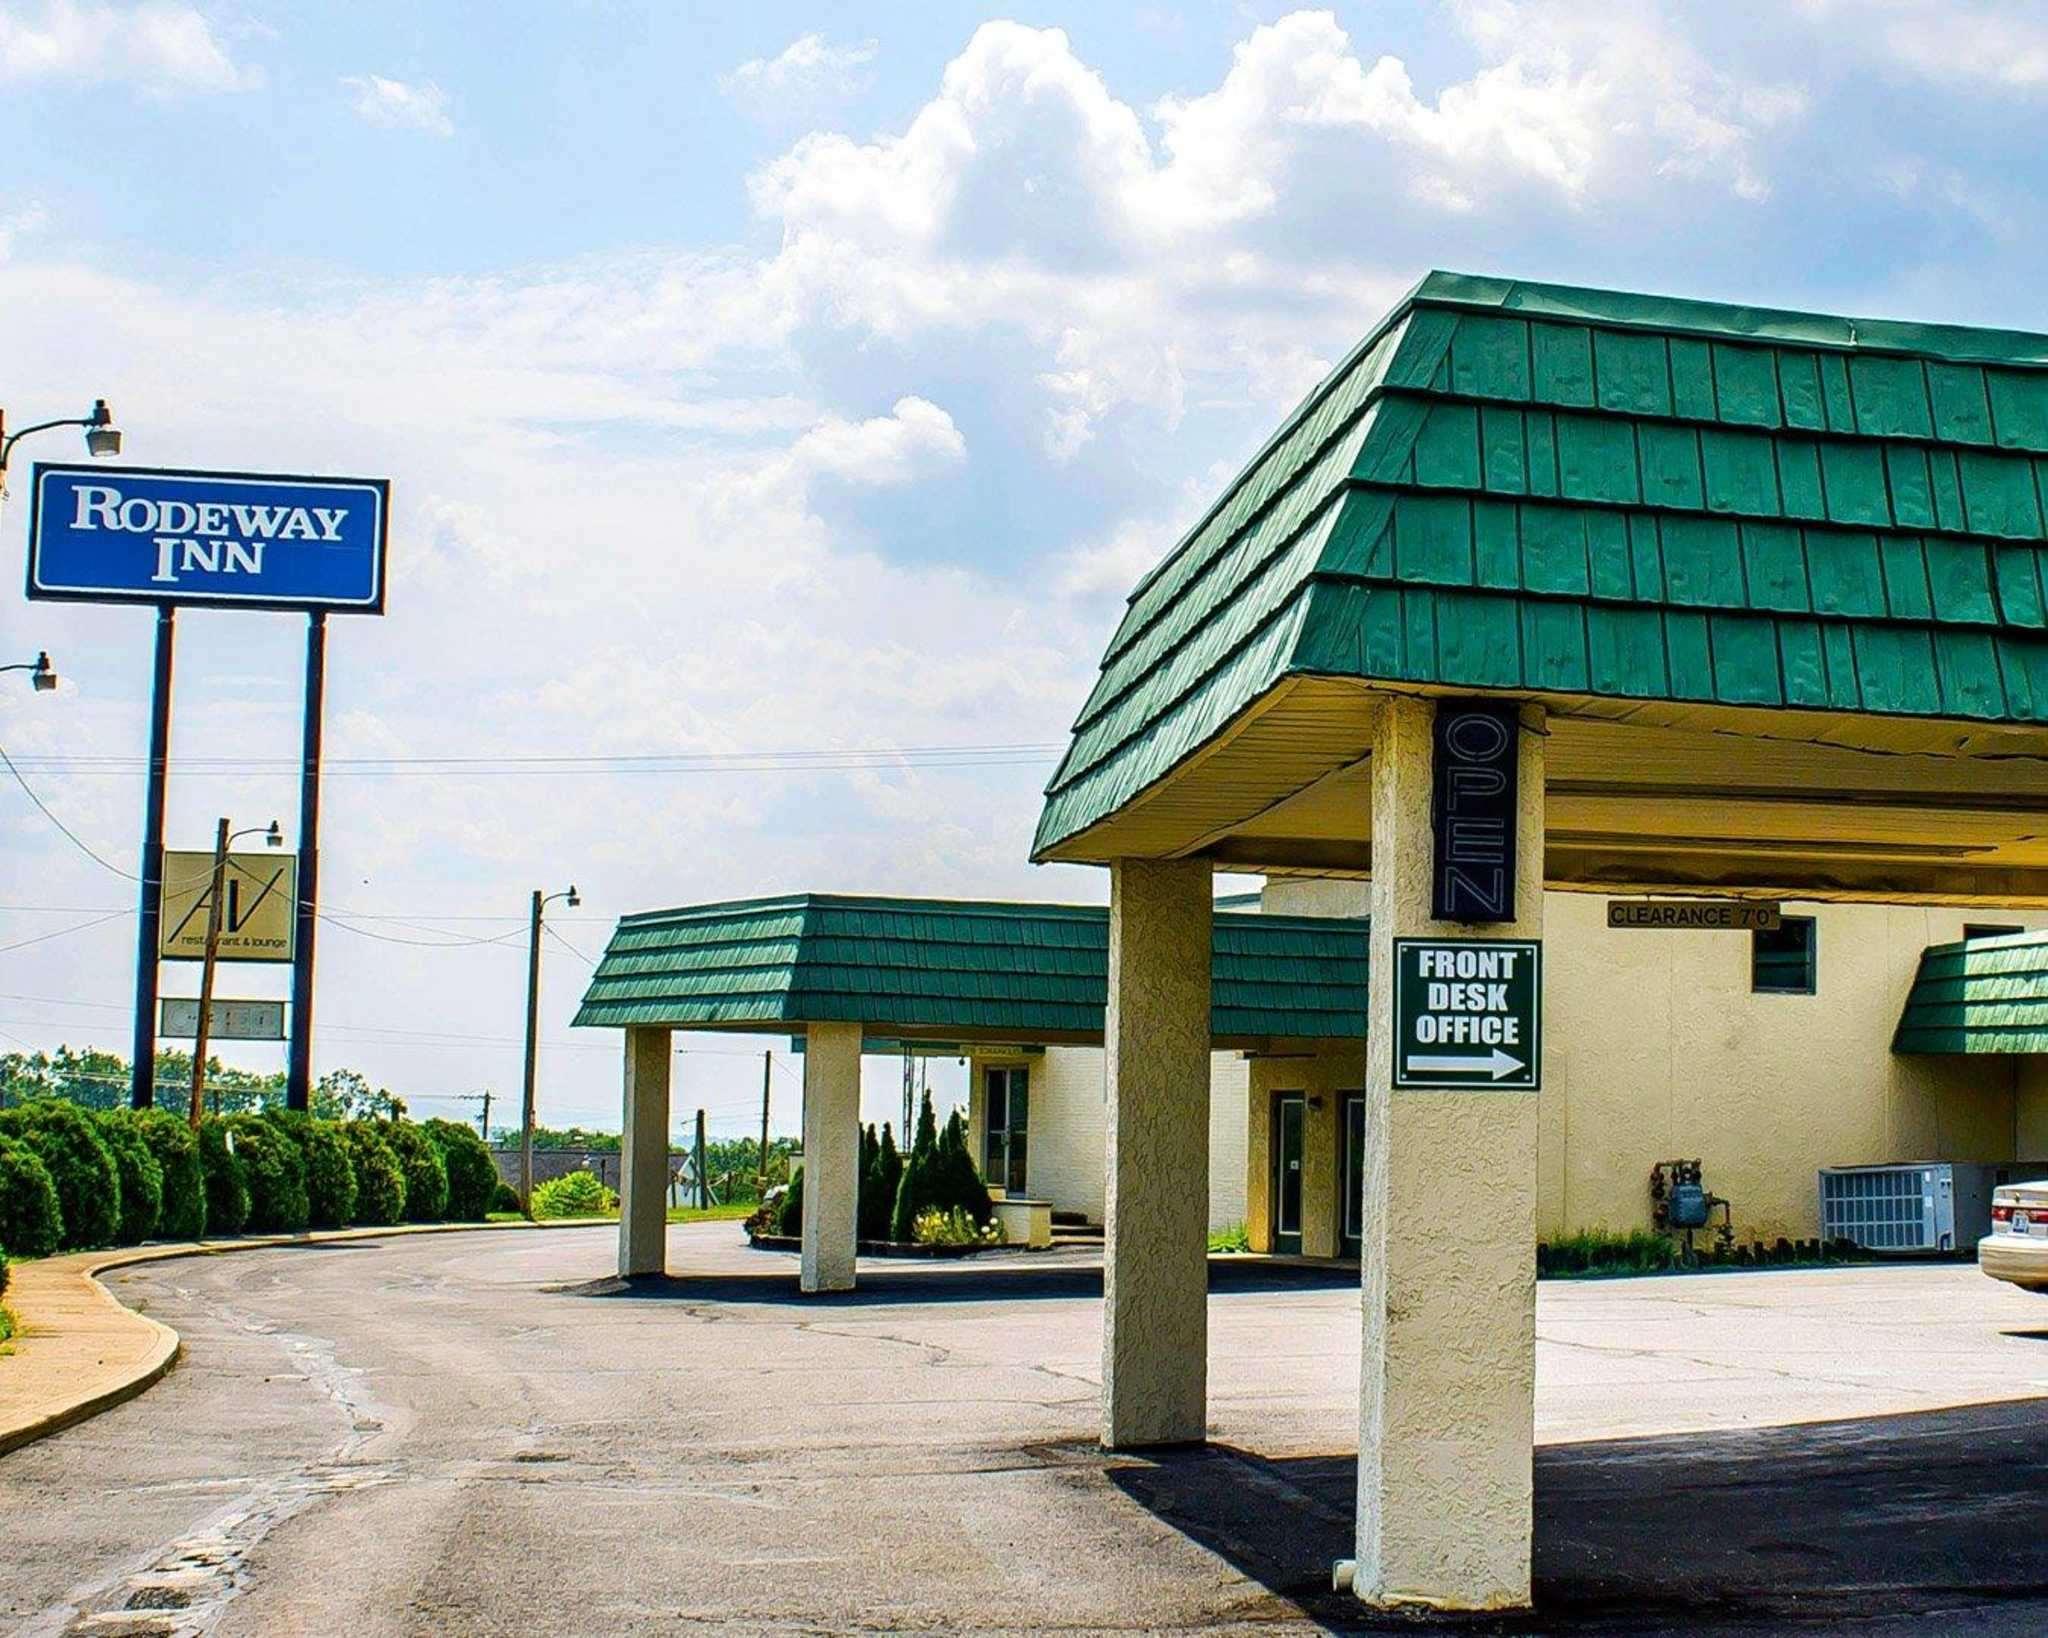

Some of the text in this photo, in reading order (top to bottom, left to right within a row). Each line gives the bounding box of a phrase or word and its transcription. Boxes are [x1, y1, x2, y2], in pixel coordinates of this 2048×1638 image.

[69, 484, 349, 541] RODEWAY
[151, 537, 266, 583] INN
[1446, 713, 1508, 914] OPEN
[1610, 906, 1731, 925] CLEARANCE
[181, 935, 287, 948] restrant & lounge
[1418, 949, 1518, 979] FRONT
[1428, 981, 1509, 1011] DESK
[1416, 1015, 1520, 1044] OFFICE
